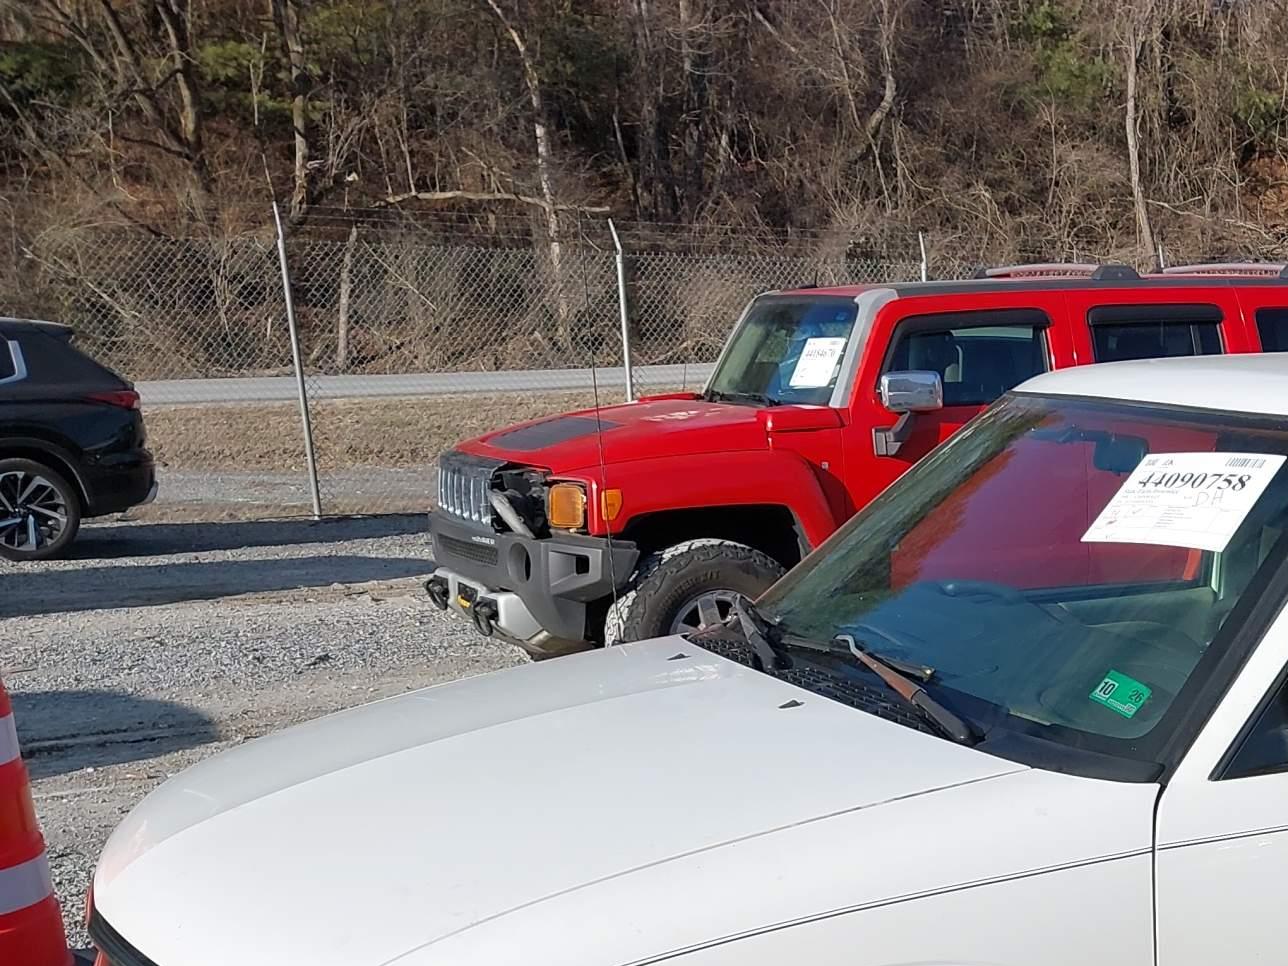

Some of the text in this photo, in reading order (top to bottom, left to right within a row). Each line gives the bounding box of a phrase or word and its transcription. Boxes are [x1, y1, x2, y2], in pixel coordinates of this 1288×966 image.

[1138, 471, 1252, 492] 44090758
[1098, 680, 1116, 696] 10
[1128, 688, 1145, 704] 26
